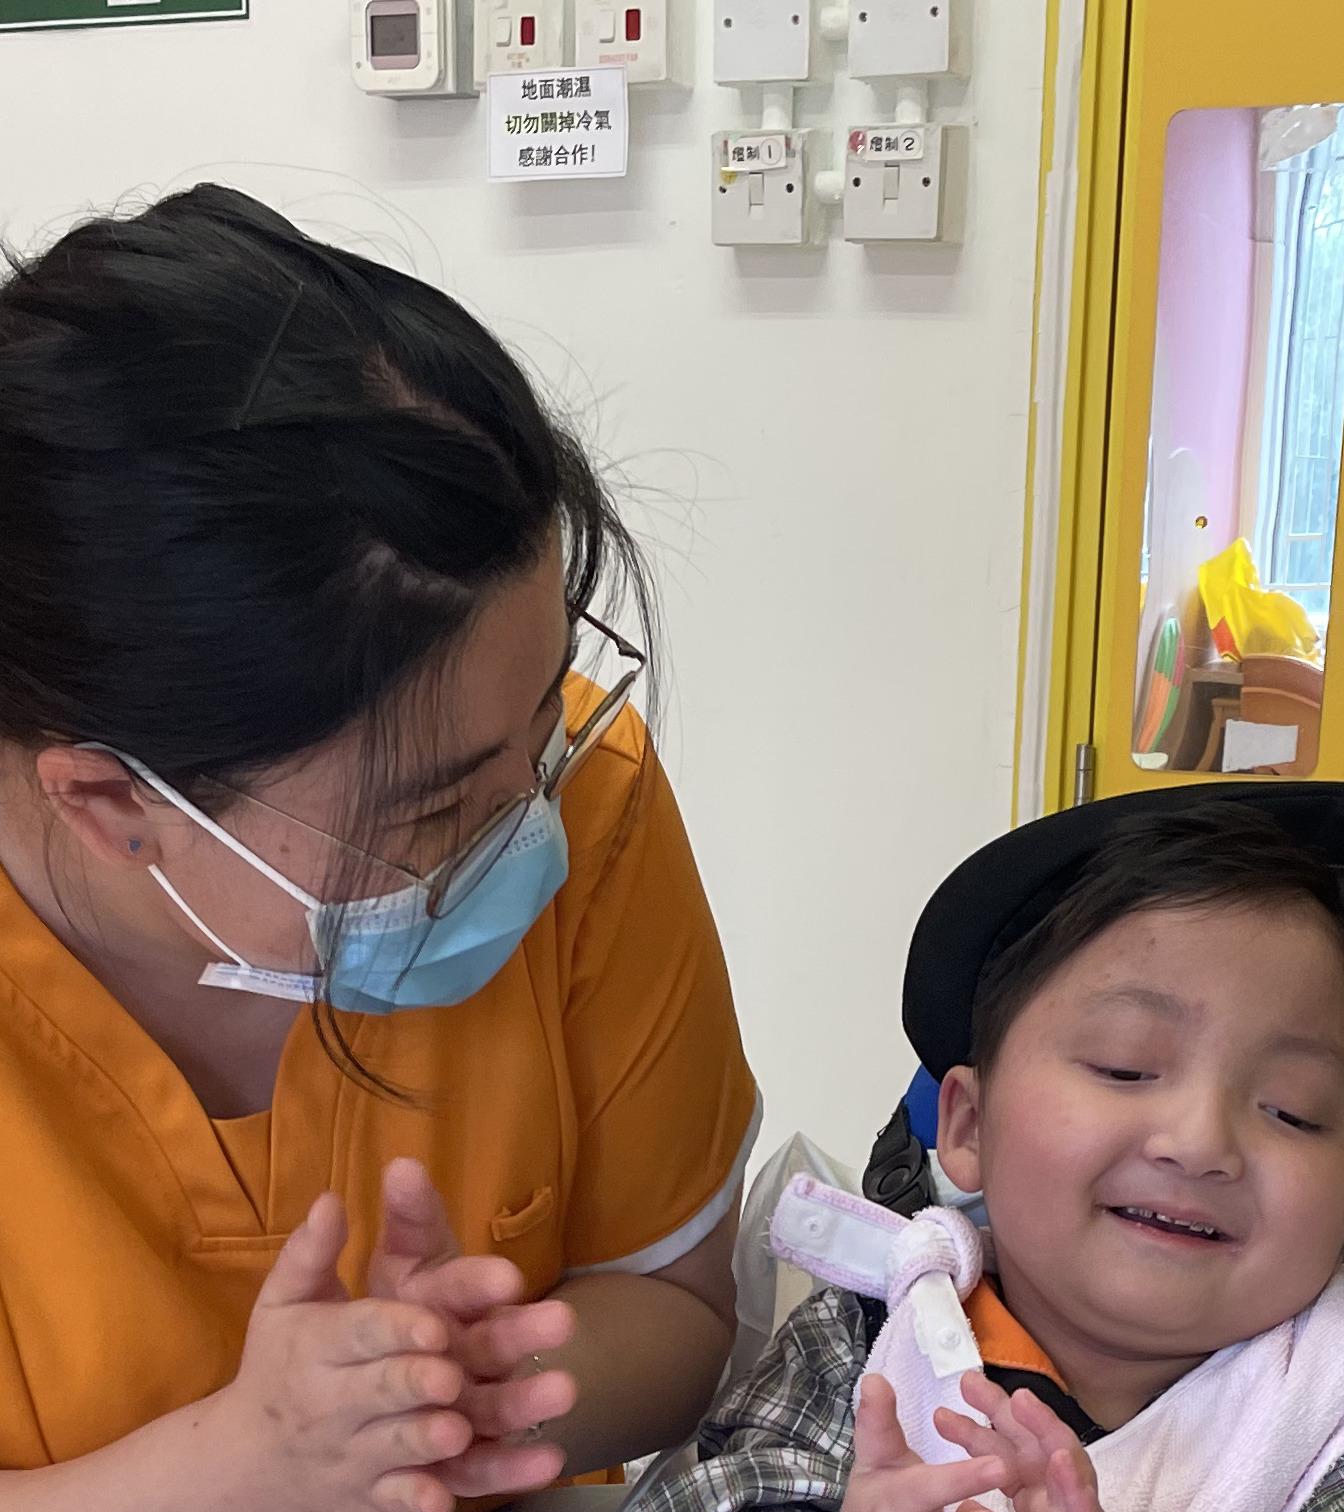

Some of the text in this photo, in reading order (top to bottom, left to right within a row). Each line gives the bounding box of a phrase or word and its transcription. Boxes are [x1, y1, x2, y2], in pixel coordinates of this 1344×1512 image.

[521, 76, 591, 100] 地面潮濕
[505, 110, 612, 135] 切勿關掉冷氣
